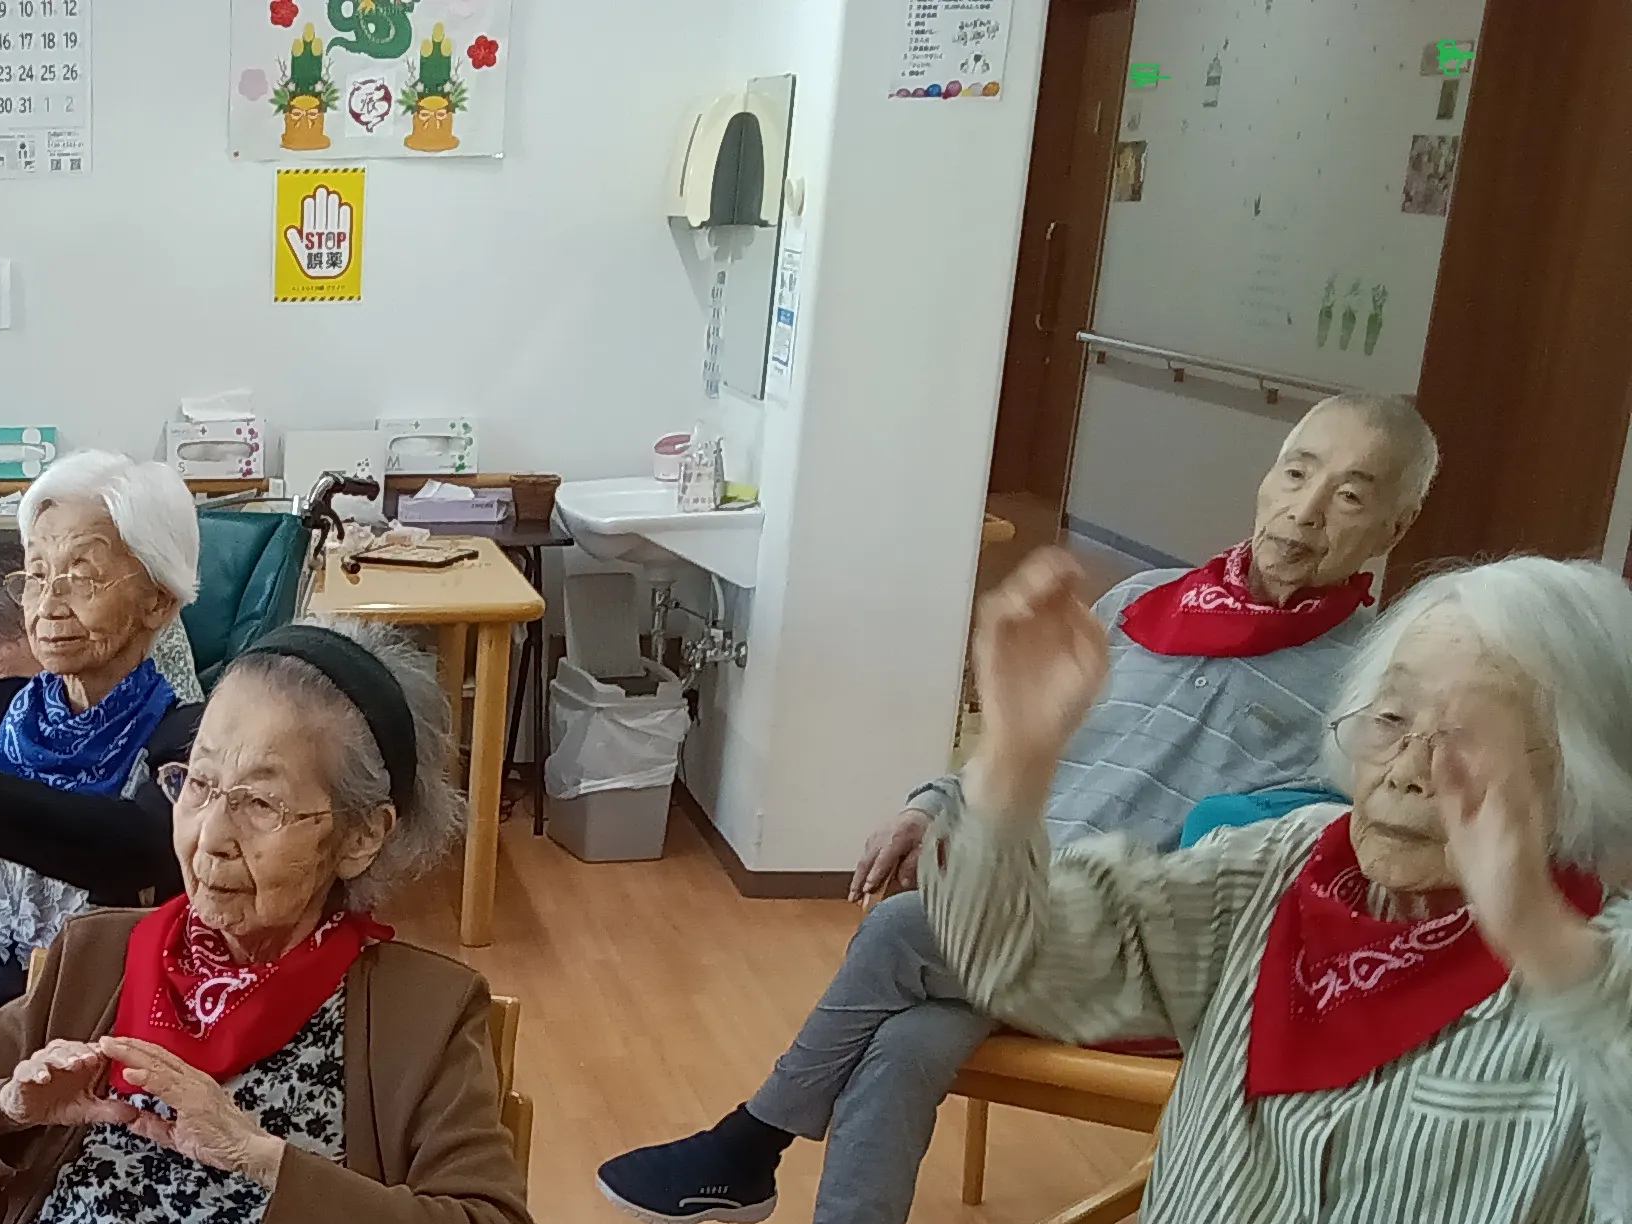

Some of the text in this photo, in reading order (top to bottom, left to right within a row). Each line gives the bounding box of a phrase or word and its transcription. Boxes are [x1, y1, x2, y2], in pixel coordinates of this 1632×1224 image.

[18, 0, 34, 17] 10
[40, 0, 53, 17] 11
[62, 0, 77, 17] 12
[18, 32, 33, 50] 17
[40, 32, 56, 49] 18
[62, 31, 78, 49] 19
[18, 65, 34, 82] 24
[40, 64, 56, 81] 25
[62, 64, 78, 81] 26
[18, 96, 32, 114] 31
[44, 97, 50, 112] 1
[65, 96, 74, 112] 2
[304, 231, 347, 250] STOP
[306, 252, 343, 270] 誤薬
[178, 461, 186, 473] S
[387, 453, 401, 469] M
